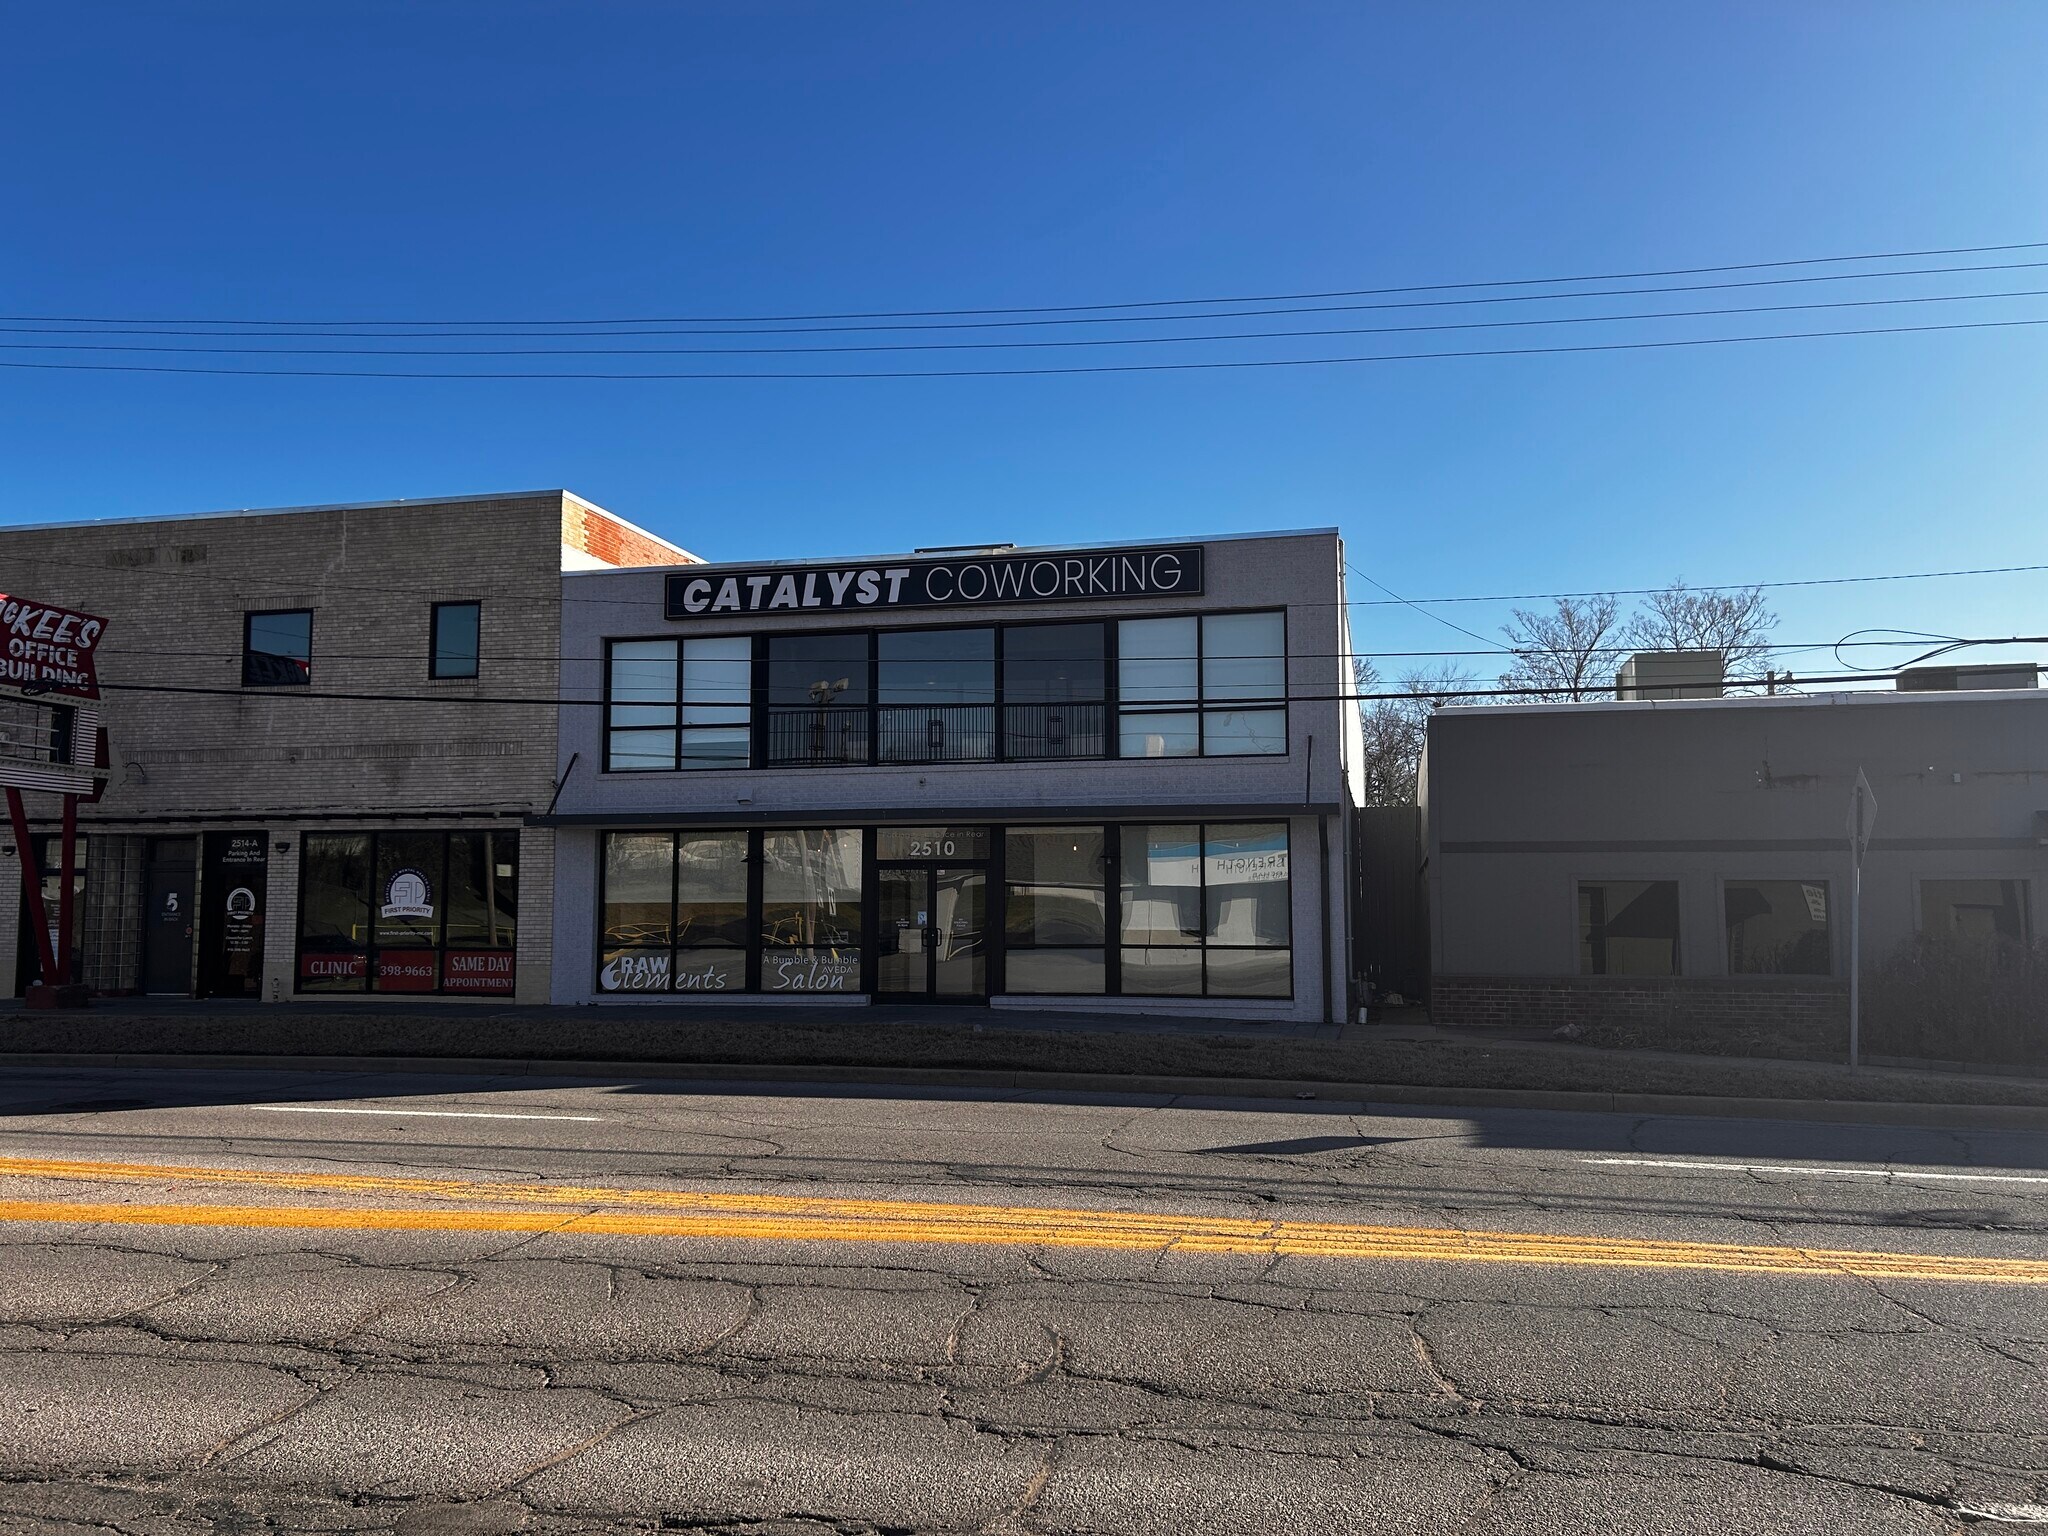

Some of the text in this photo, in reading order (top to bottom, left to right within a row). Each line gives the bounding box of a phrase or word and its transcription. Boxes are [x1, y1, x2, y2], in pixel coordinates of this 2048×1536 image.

[683, 554, 1182, 612] CATALYST COWORKING
[9, 638, 79, 668] OFFICE
[232, 839, 258, 847] 2514-A
[910, 840, 955, 856] 2510
[402, 906, 431, 914] PRIORITY
[452, 957, 512, 971] SAME DAY
[621, 957, 669, 973] RAW
[763, 955, 858, 964] A Bumble & Bumble
[310, 961, 357, 974] CLINIC
[380, 965, 432, 976] 398-9663
[773, 961, 844, 989] Salon
